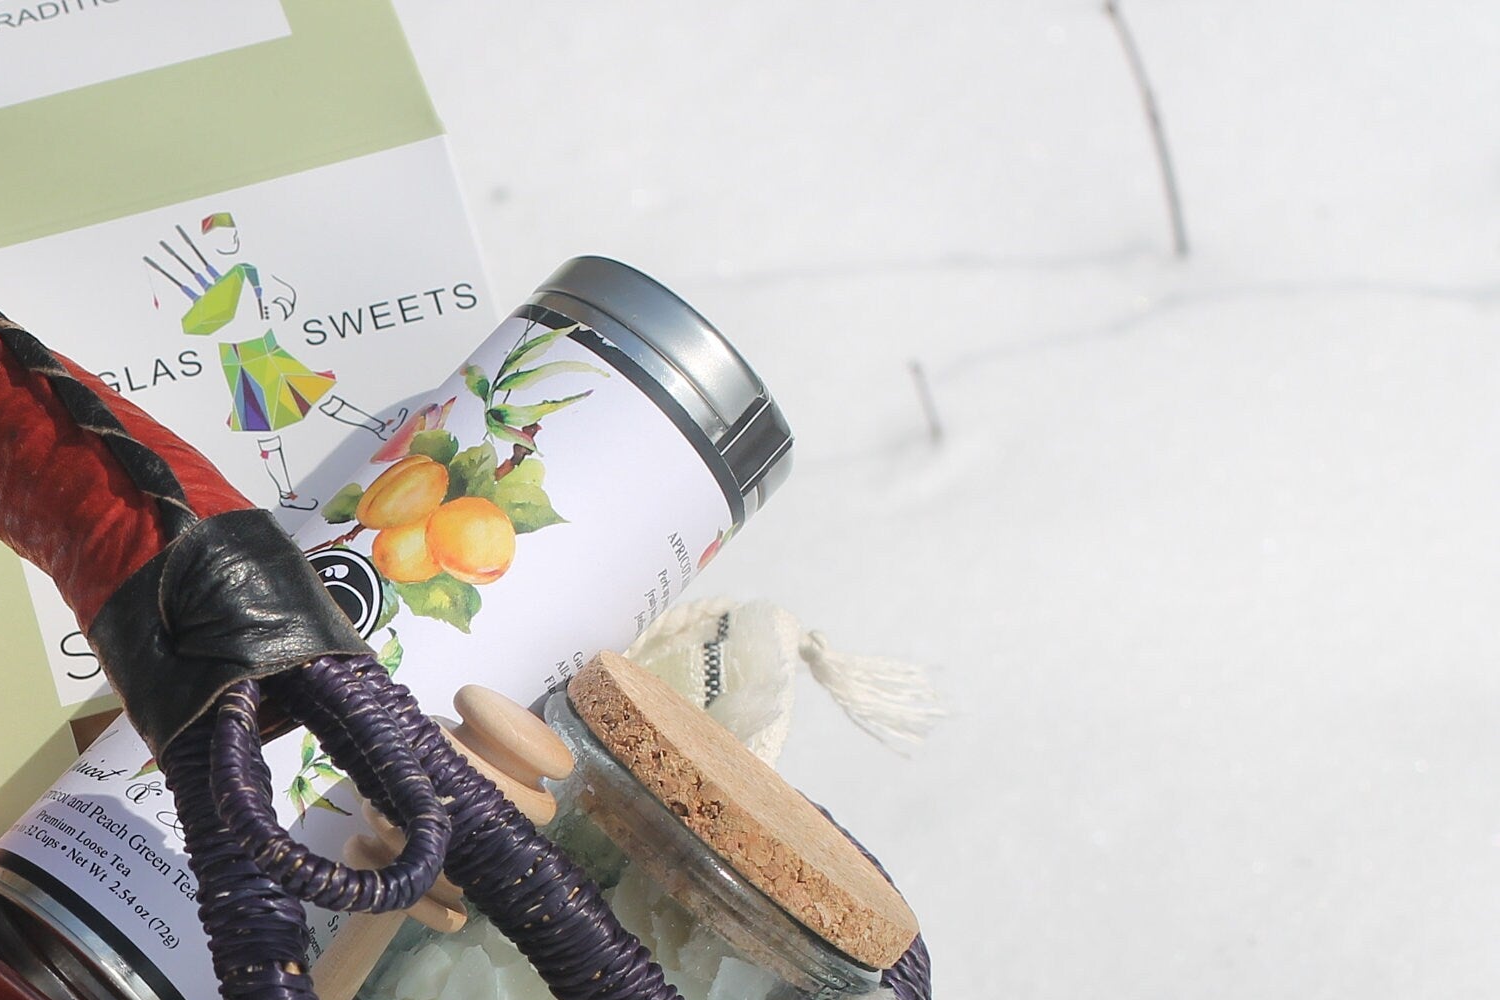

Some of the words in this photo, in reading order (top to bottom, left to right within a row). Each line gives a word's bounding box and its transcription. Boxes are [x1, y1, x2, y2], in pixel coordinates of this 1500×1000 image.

[303, 283, 478, 346] SWEETS
[36, 810, 76, 836] Premium
[75, 830, 109, 859] Loose
[109, 853, 132, 878] Tea
[67, 797, 93, 814] and
[87, 805, 128, 840] Peach
[128, 834, 173, 876] Green
[171, 869, 198, 901] Tea
[35, 829, 60, 848] Cups
[65, 847, 89, 868] Net
[88, 862, 108, 882] Wt
[108, 880, 138, 906] 2.54
[134, 904, 150, 920] oz
[148, 917, 180, 950] (72g)
